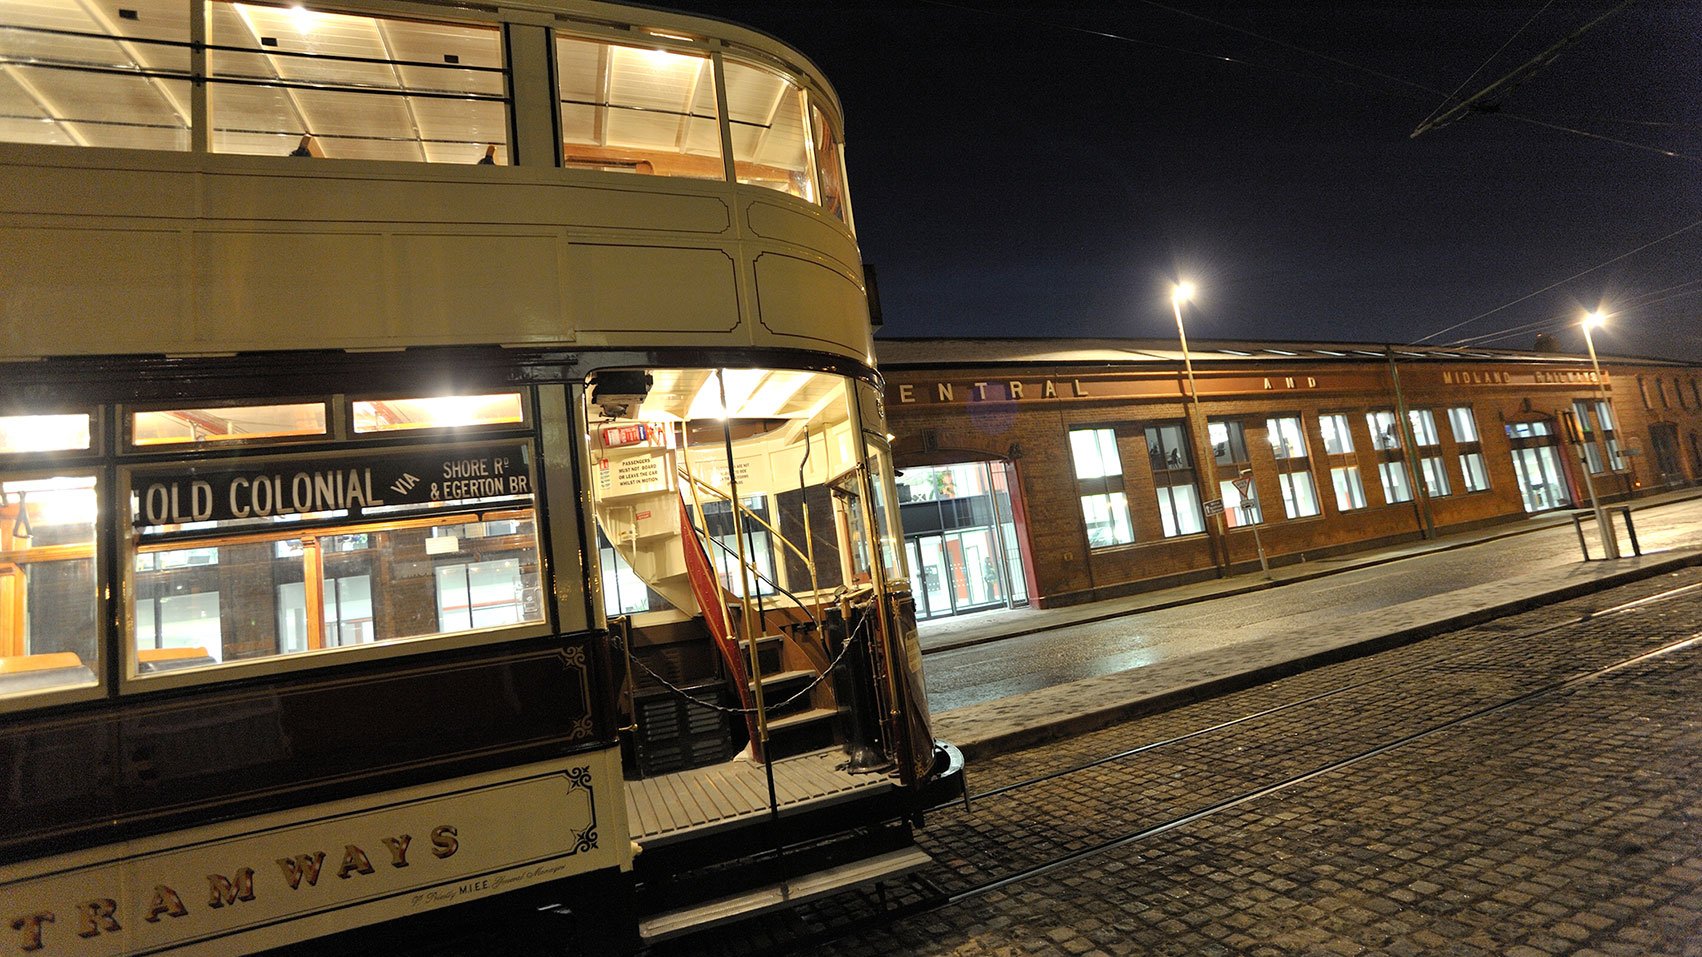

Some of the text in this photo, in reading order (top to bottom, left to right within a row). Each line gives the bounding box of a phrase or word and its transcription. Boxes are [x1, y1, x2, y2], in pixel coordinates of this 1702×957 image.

[1263, 376, 1317, 389] AND
[1443, 371, 1512, 385] MIDLAND
[1534, 371, 1600, 384] RAILWAYS
[443, 458, 489, 479] SHORE
[146, 468, 420, 525] OLD COLONIAL VIA
[430, 475, 528, 501] & EGERTON BR
[9, 824, 460, 953] TRAMWAYS
